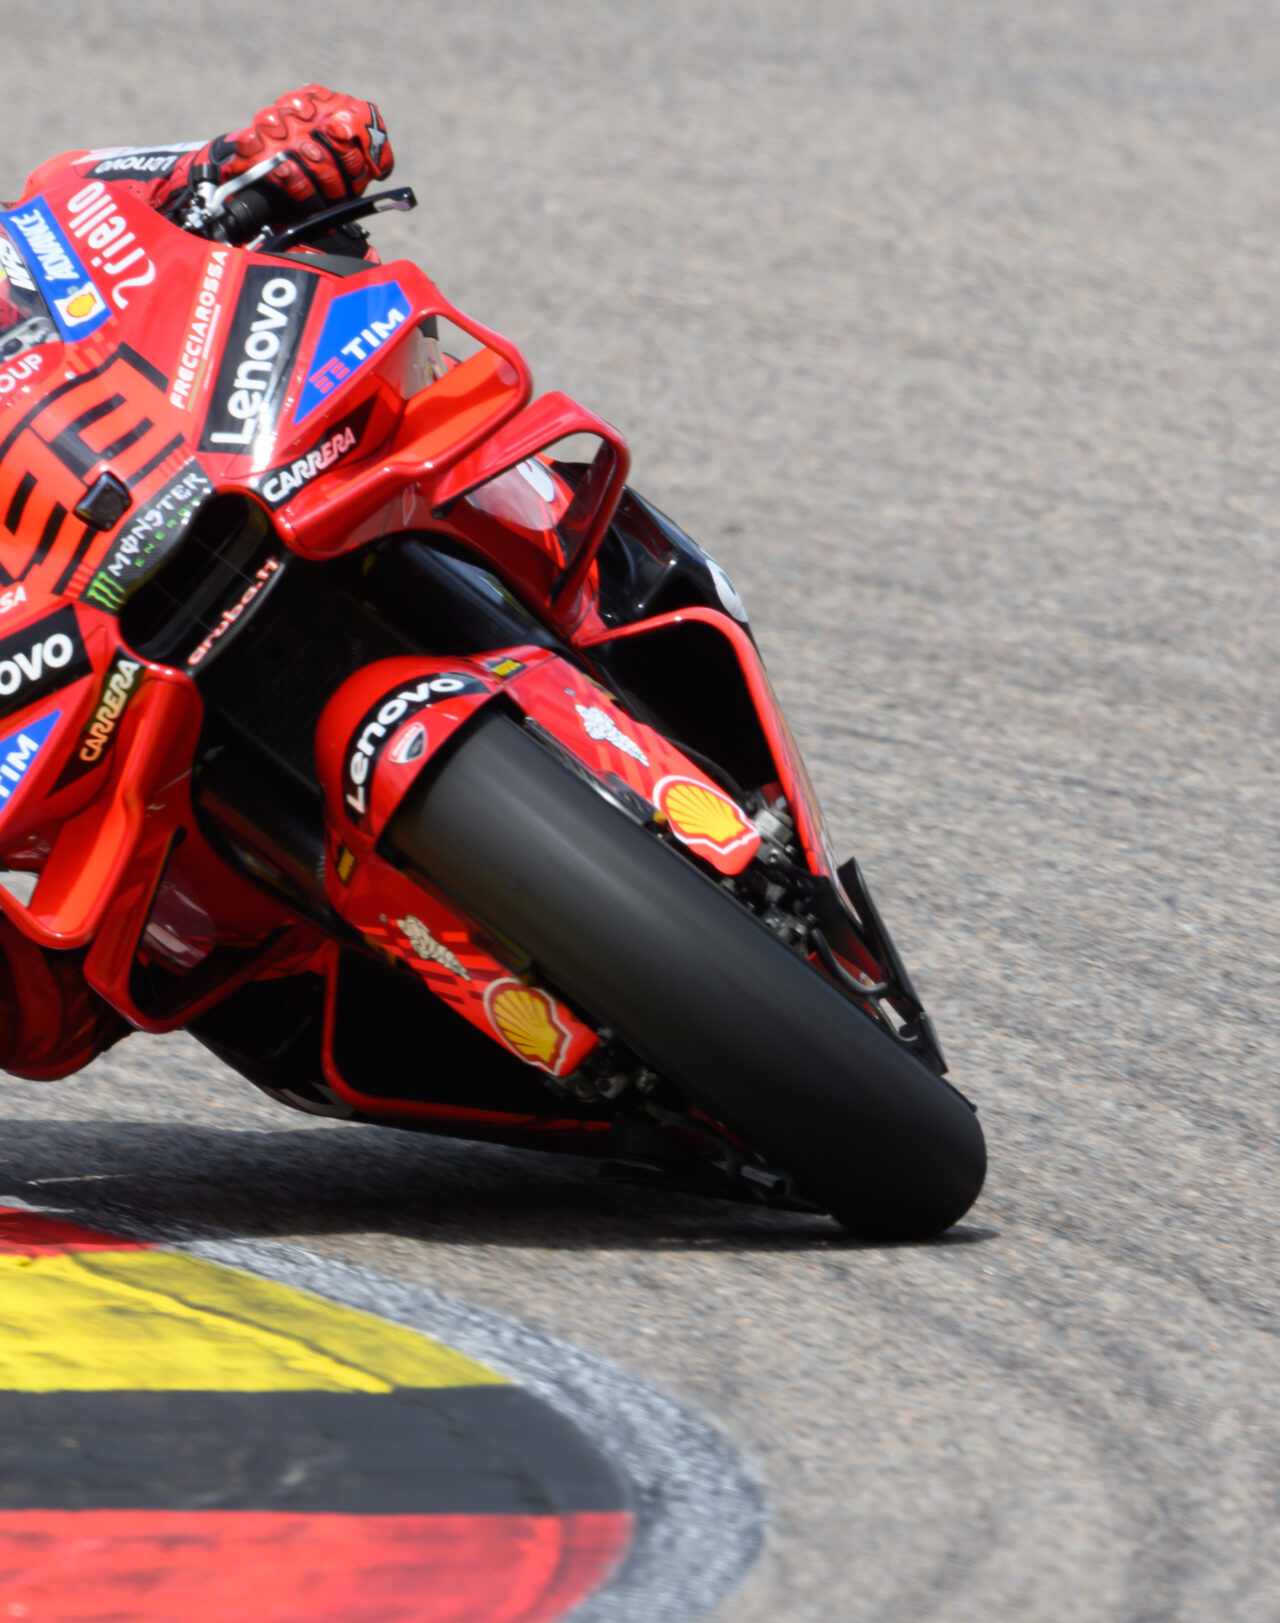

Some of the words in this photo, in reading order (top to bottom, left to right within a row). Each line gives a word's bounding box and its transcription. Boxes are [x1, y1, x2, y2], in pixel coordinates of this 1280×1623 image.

[9, 209, 80, 281] ADVANCE
[67, 181, 147, 276] riello
[169, 251, 229, 410] FRECCIAROSSA
[210, 278, 298, 445] Lenovo
[339, 306, 407, 362] TIM
[261, 425, 356, 502] CARRERA
[107, 472, 209, 577] MONSTER
[78, 658, 143, 762] CARRERA
[345, 678, 465, 814] Lenovo
